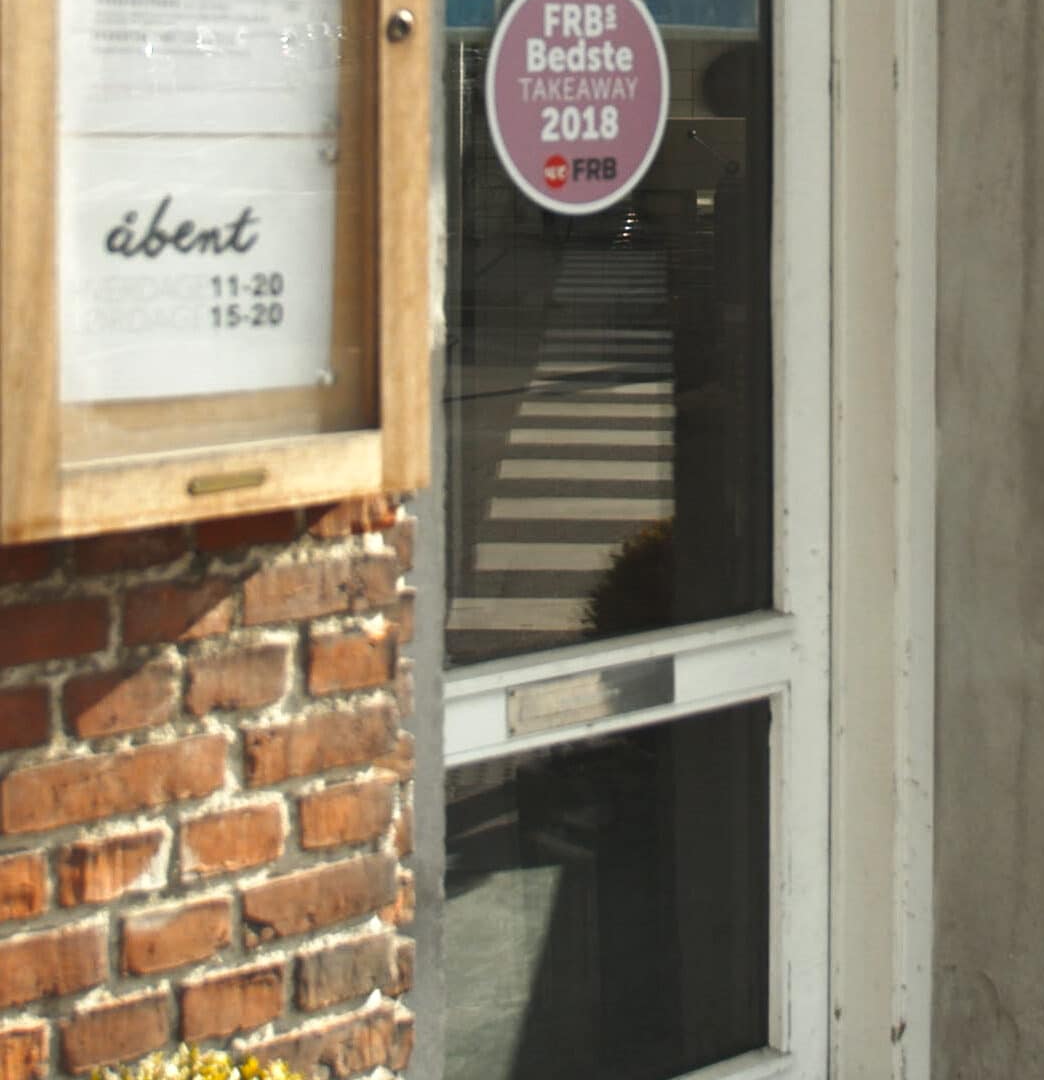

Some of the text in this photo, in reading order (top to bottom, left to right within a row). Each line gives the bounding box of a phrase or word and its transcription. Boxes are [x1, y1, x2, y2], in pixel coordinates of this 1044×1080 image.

[526, 38, 634, 72] Bedste
[518, 76, 638, 102] TAKEAWAY
[541, 105, 619, 142] 2018
[572, 156, 618, 182] FRB
[211, 272, 284, 298] 11-20
[211, 302, 284, 328] 15-20
